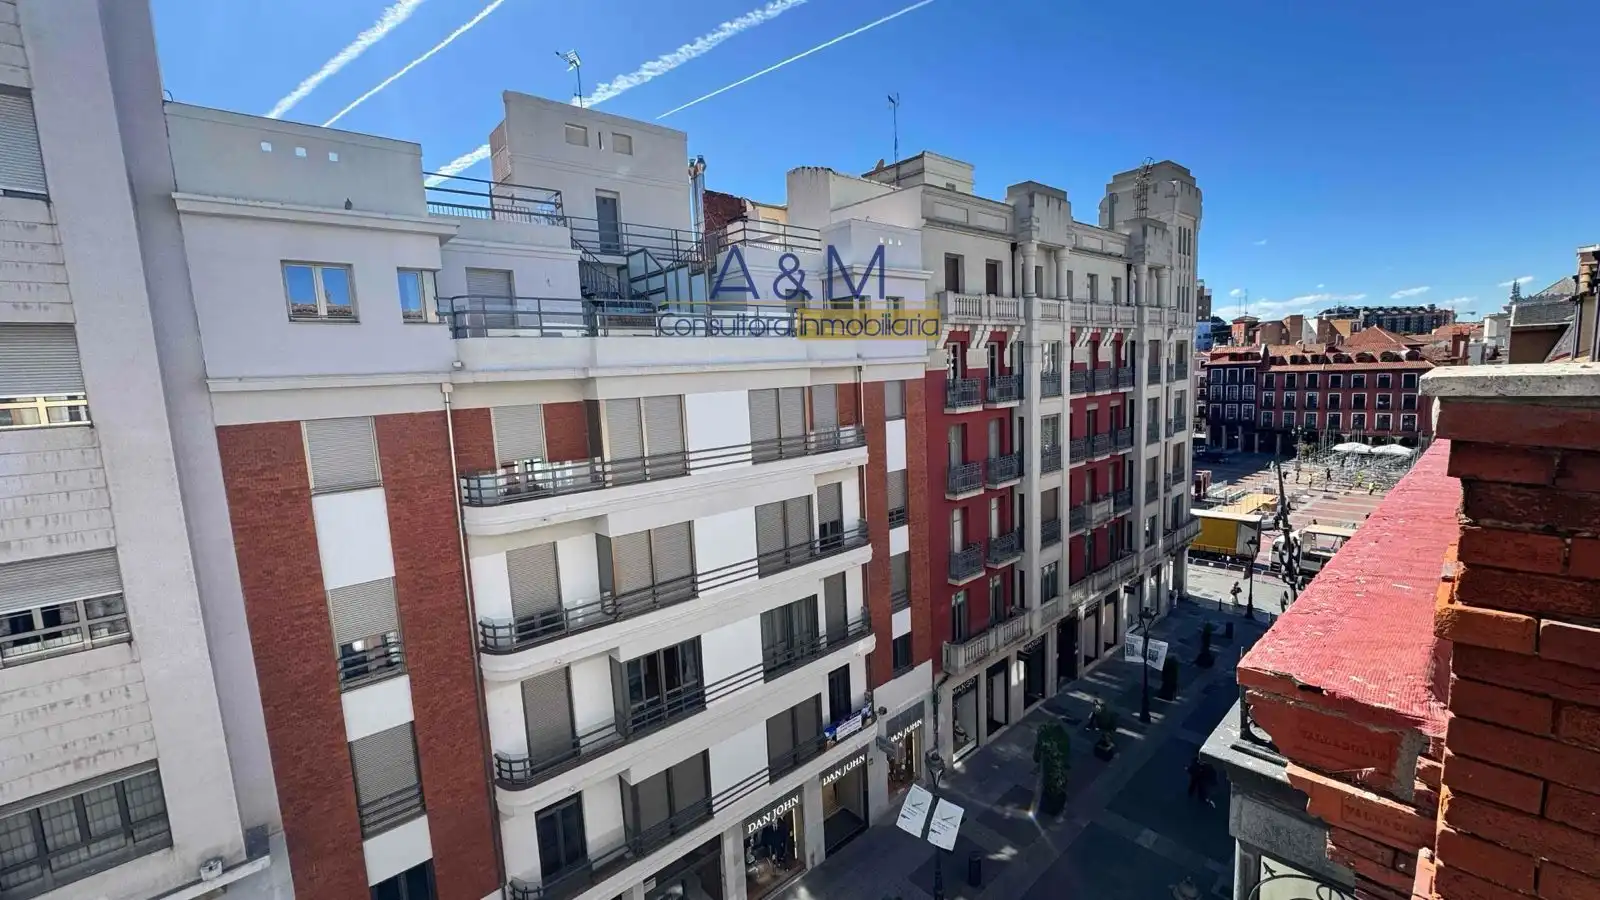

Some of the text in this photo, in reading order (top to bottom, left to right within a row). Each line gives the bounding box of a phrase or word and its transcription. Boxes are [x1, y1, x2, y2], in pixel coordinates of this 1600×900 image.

[903, 719, 922, 738] JOHN
[823, 754, 865, 786] DAN JOHN
[747, 795, 799, 834] DAN JOHN
